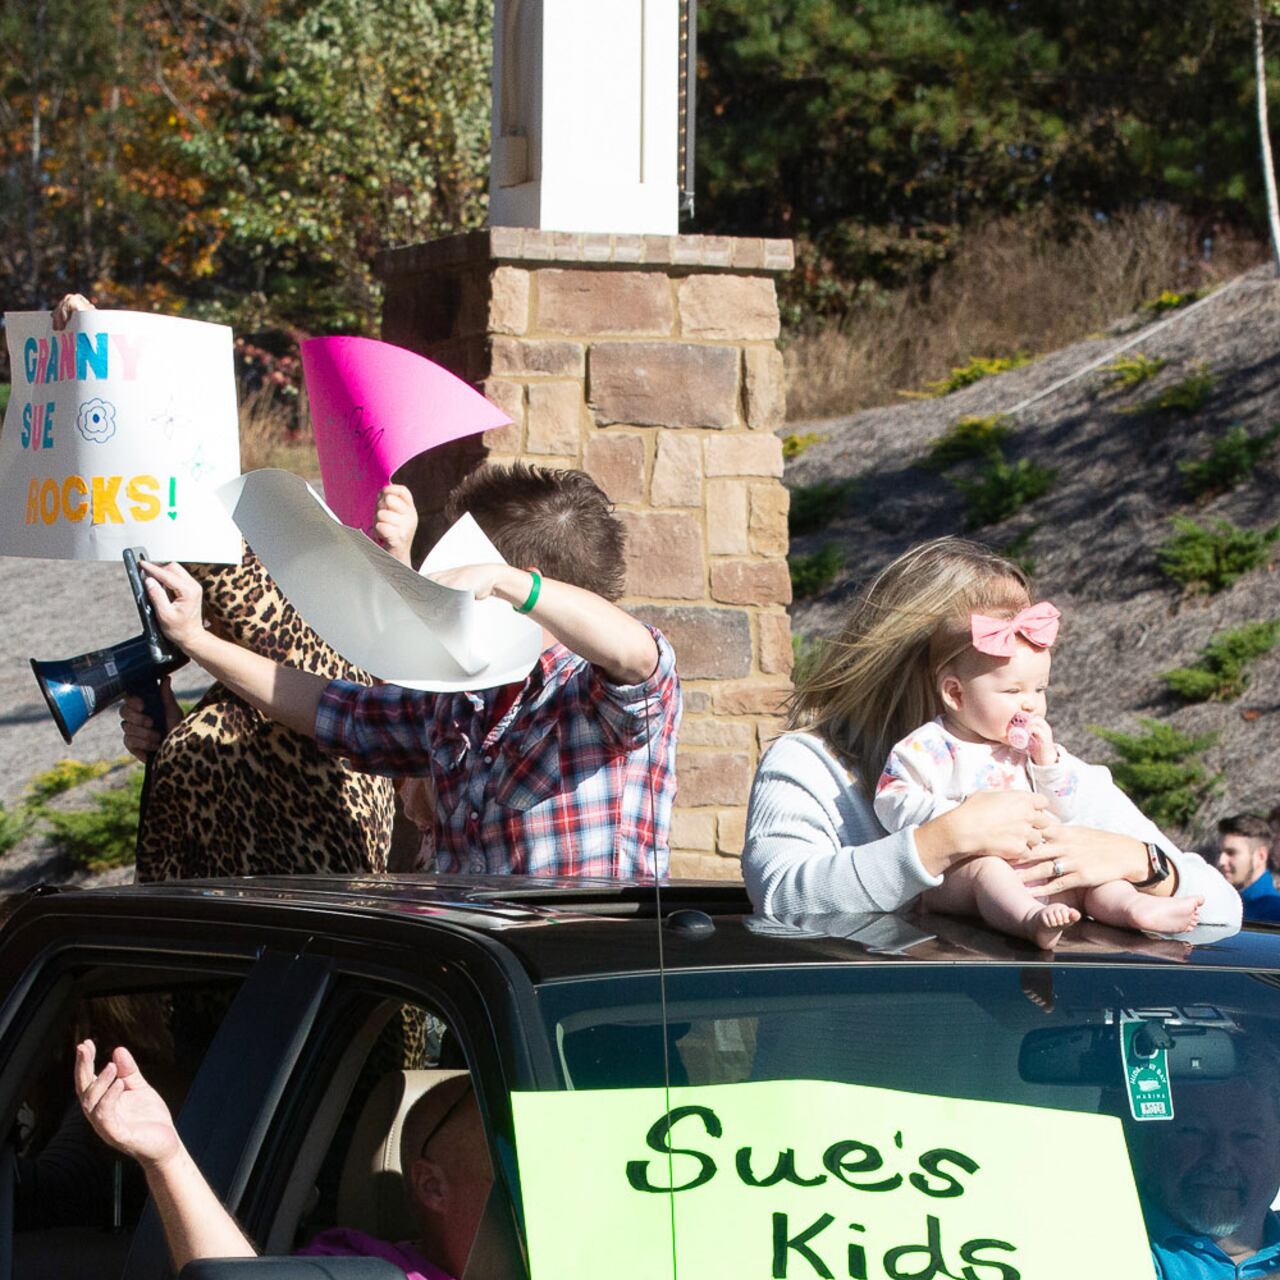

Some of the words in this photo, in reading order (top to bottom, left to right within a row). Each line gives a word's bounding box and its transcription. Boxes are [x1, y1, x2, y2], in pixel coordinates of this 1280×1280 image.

[23, 331, 144, 385] GRANNY
[20, 401, 55, 450] SUE
[24, 475, 179, 526] ROCKS!
[625, 1105, 982, 1199] Sue's
